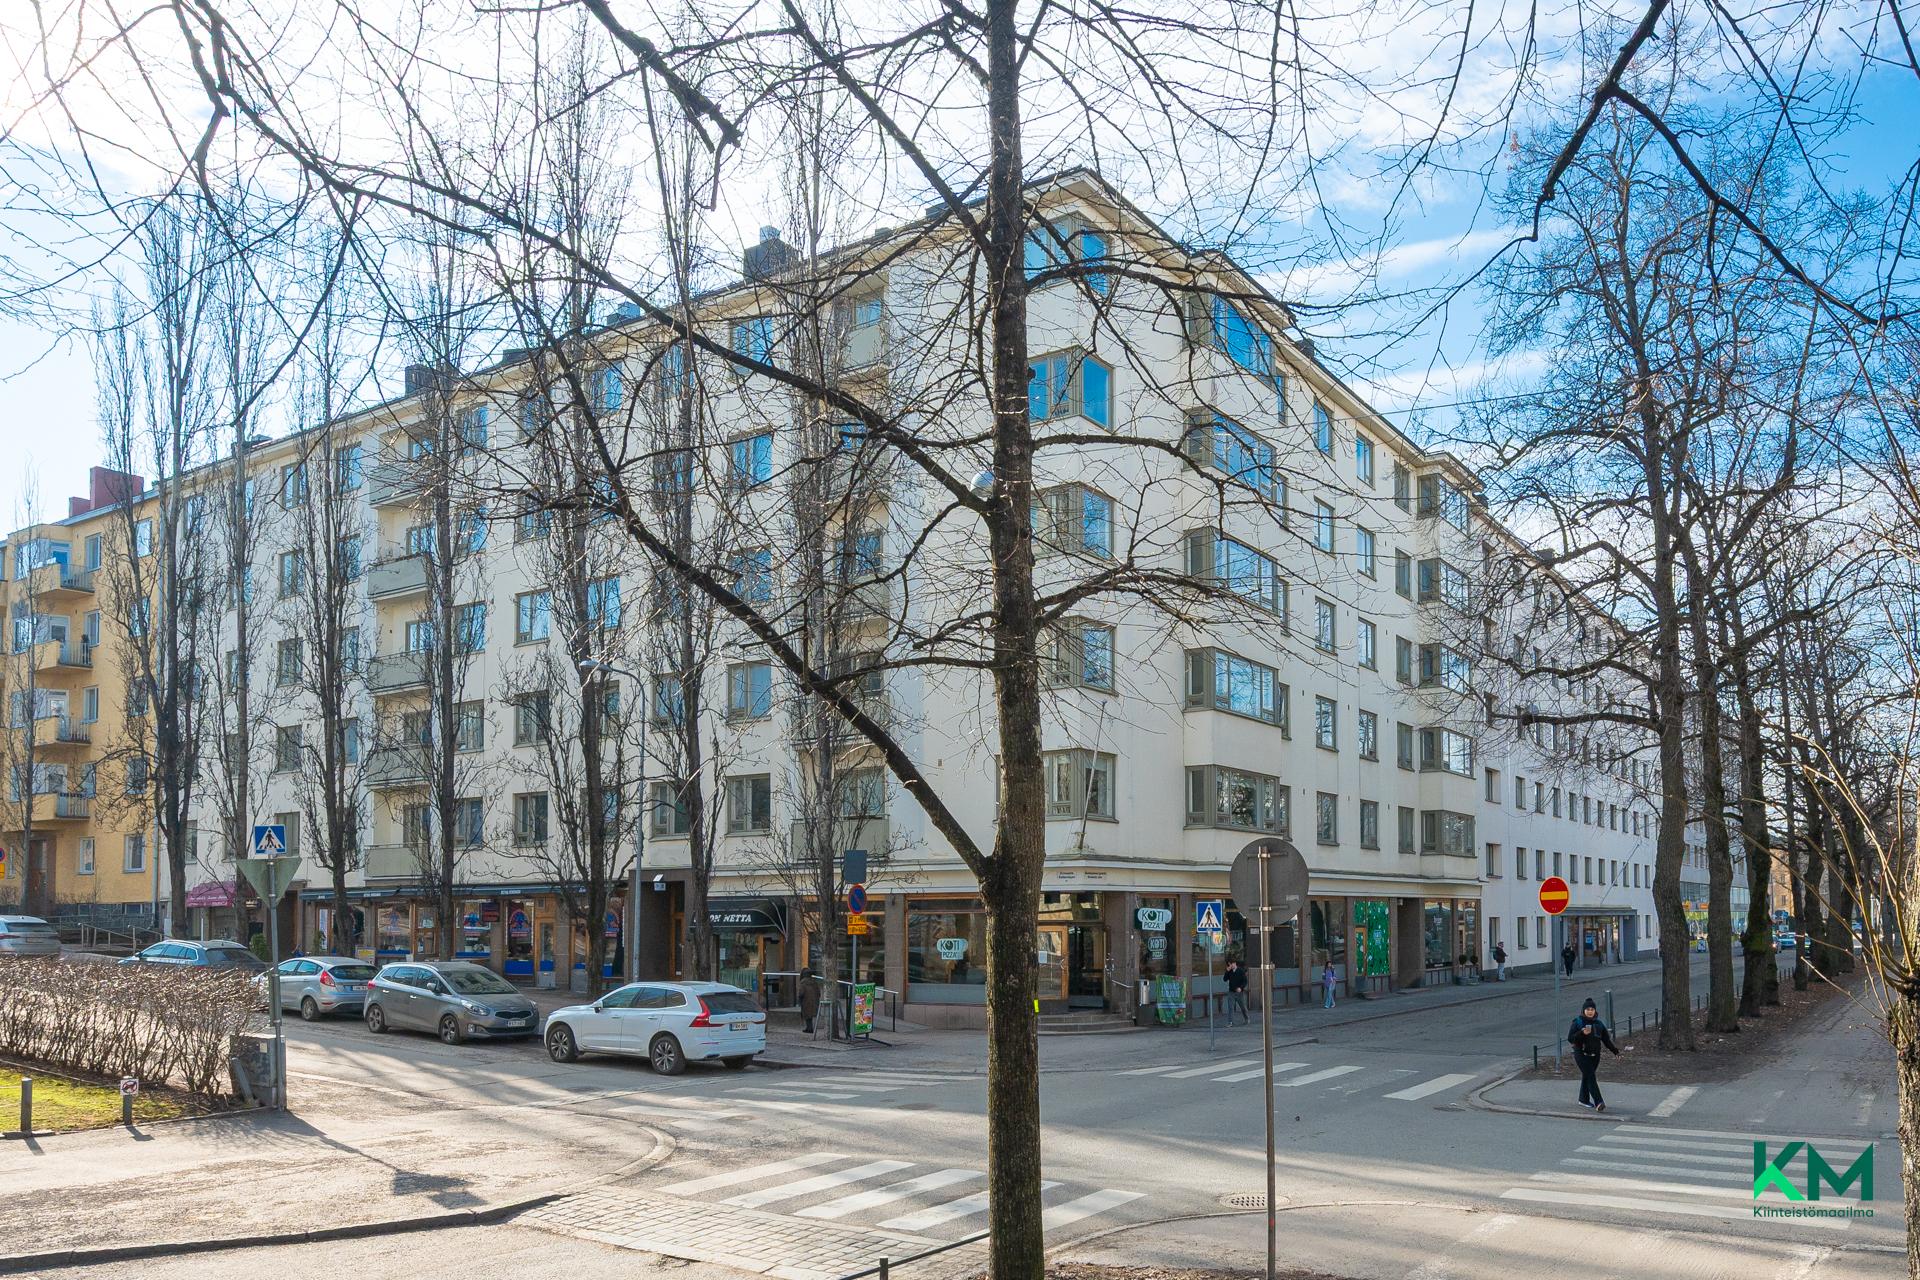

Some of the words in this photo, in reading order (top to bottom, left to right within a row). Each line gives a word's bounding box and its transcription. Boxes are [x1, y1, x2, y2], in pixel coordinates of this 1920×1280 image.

[723, 913, 752, 923] NETTA
[1141, 909, 1164, 922] KOTI
[940, 939, 960, 951] KOTI
[1150, 938, 1165, 949] KOTI
